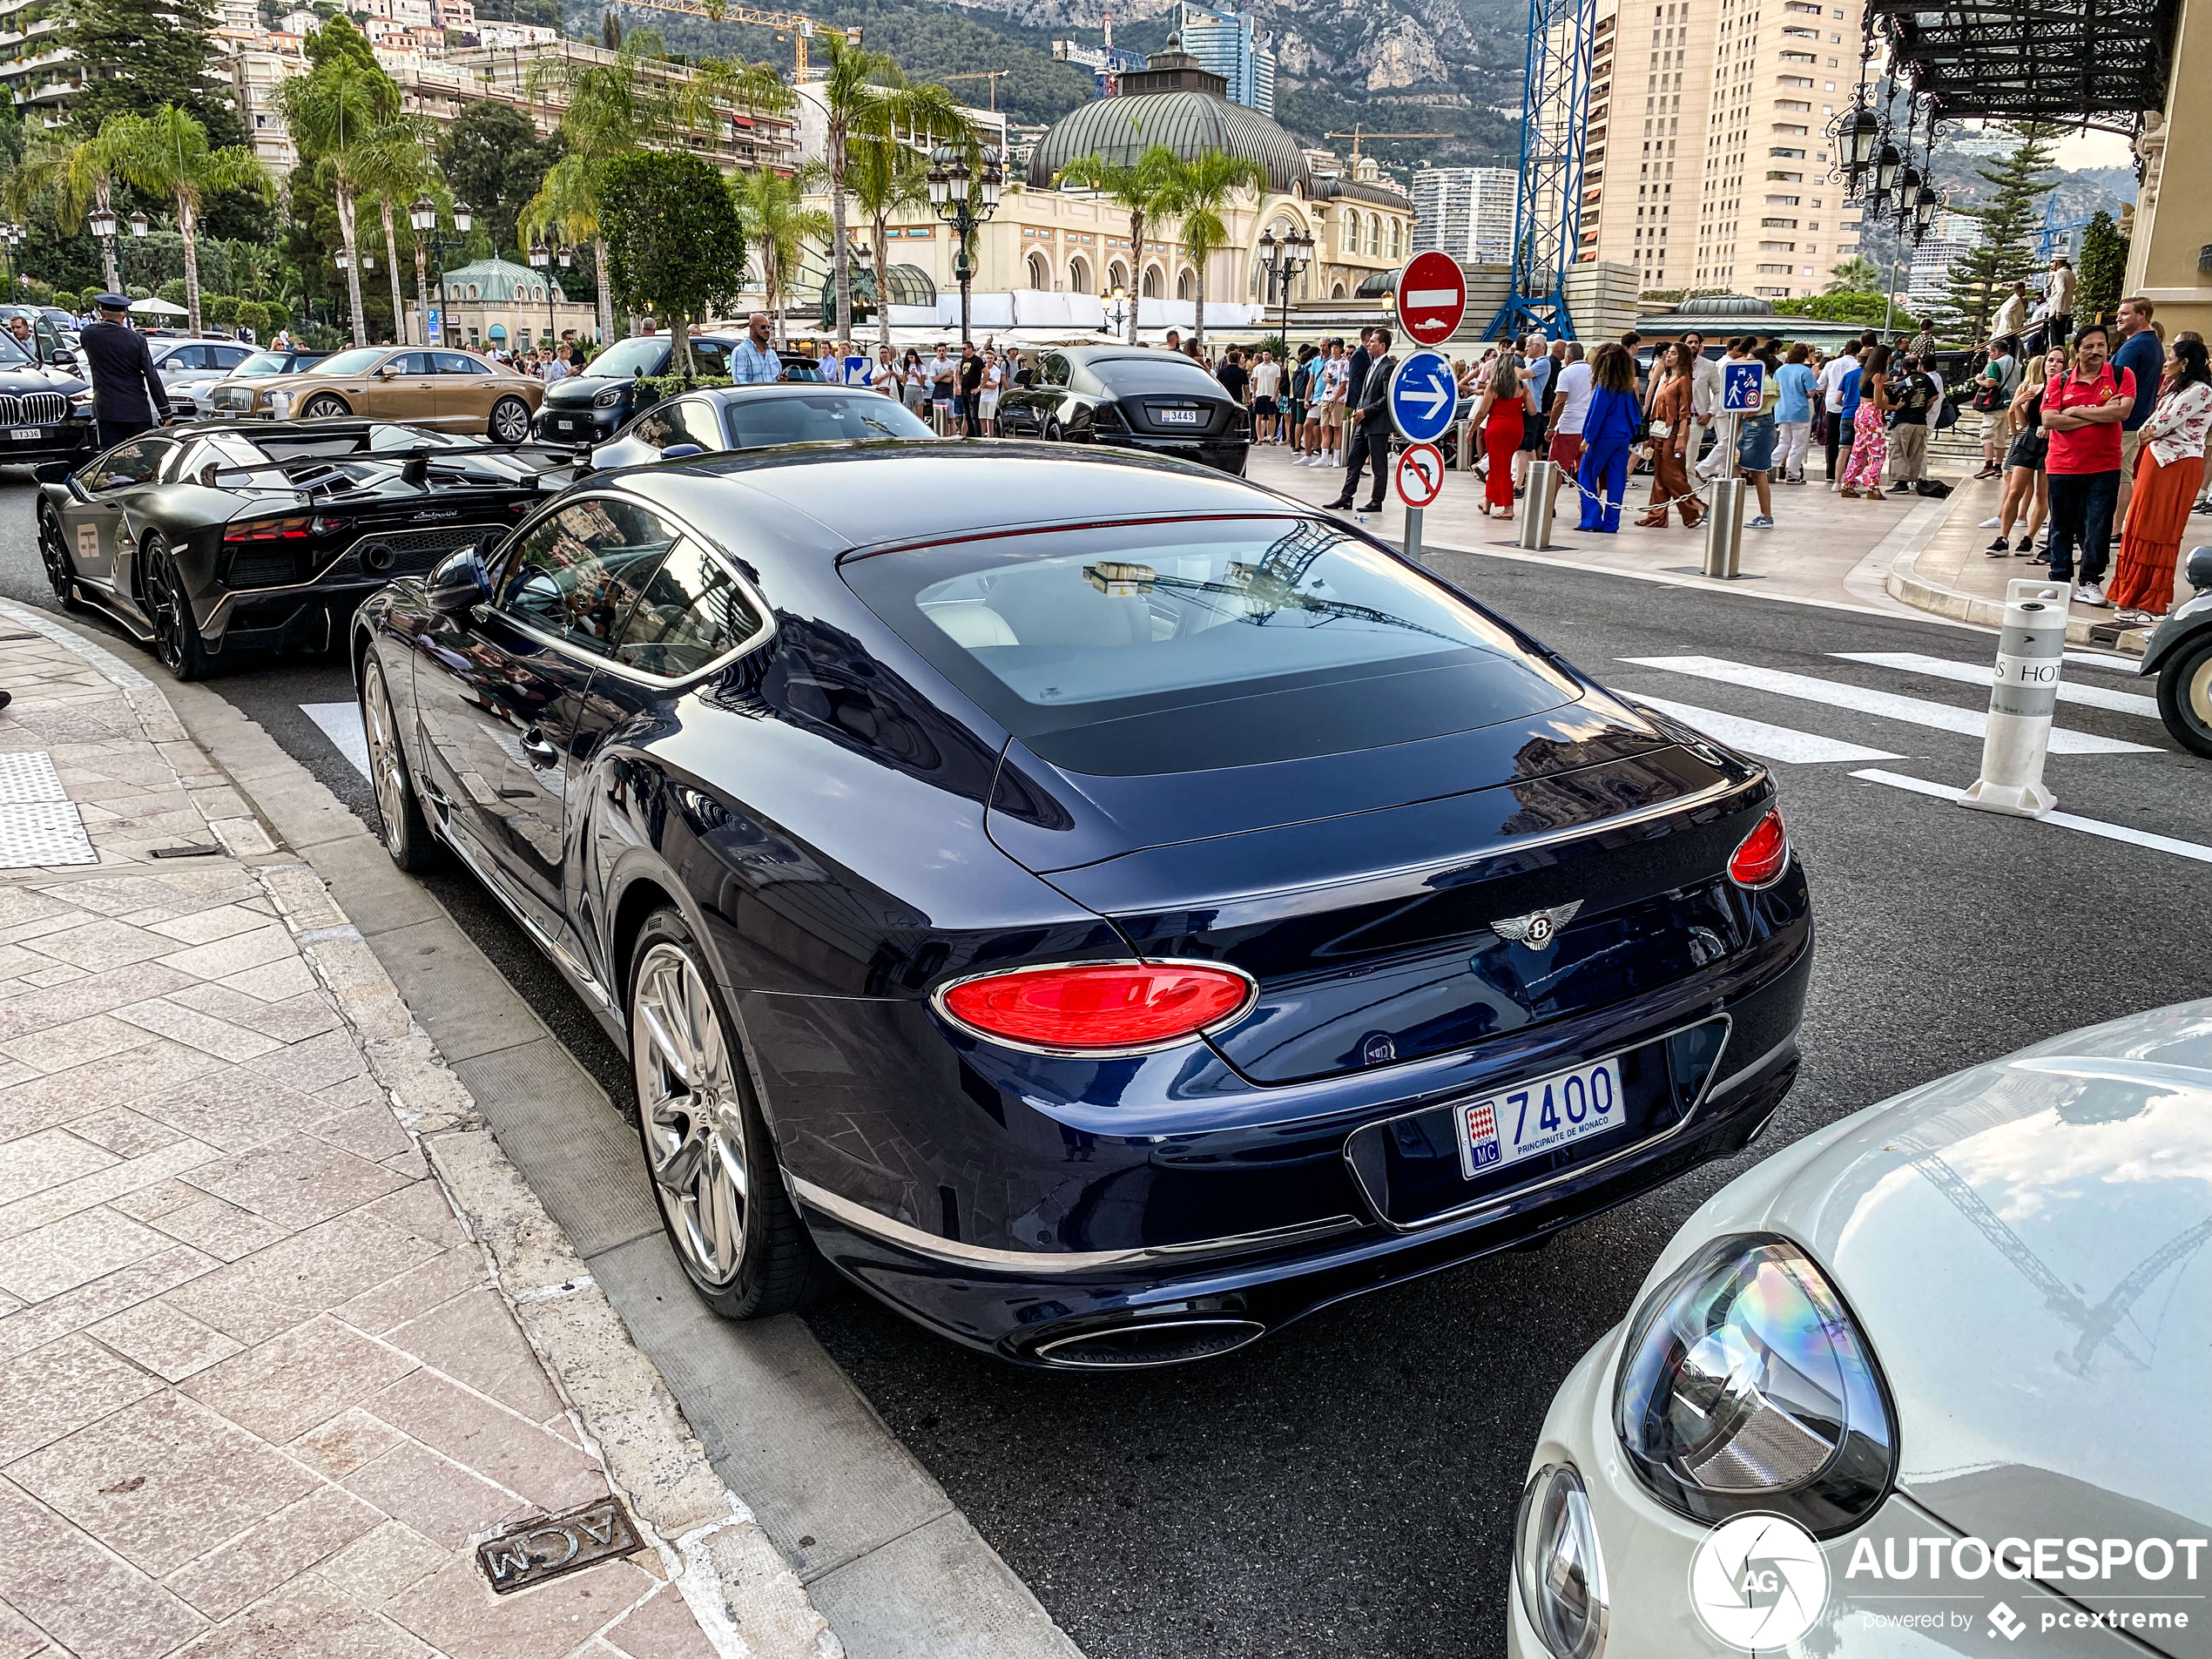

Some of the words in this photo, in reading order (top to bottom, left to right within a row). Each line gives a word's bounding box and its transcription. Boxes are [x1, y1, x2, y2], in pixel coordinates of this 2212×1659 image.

[1171, 411, 1194, 420] 344S
[1507, 1066, 1613, 1145] 7400
[1477, 1136, 1492, 1146] 2022
[1517, 1132, 1565, 1155] PRINCIPAUTE
[1567, 1127, 1577, 1138] DE
[1579, 1116, 1608, 1134] MONACO
[1477, 1144, 1496, 1164] MC
[486, 1512, 614, 1580] ACM
